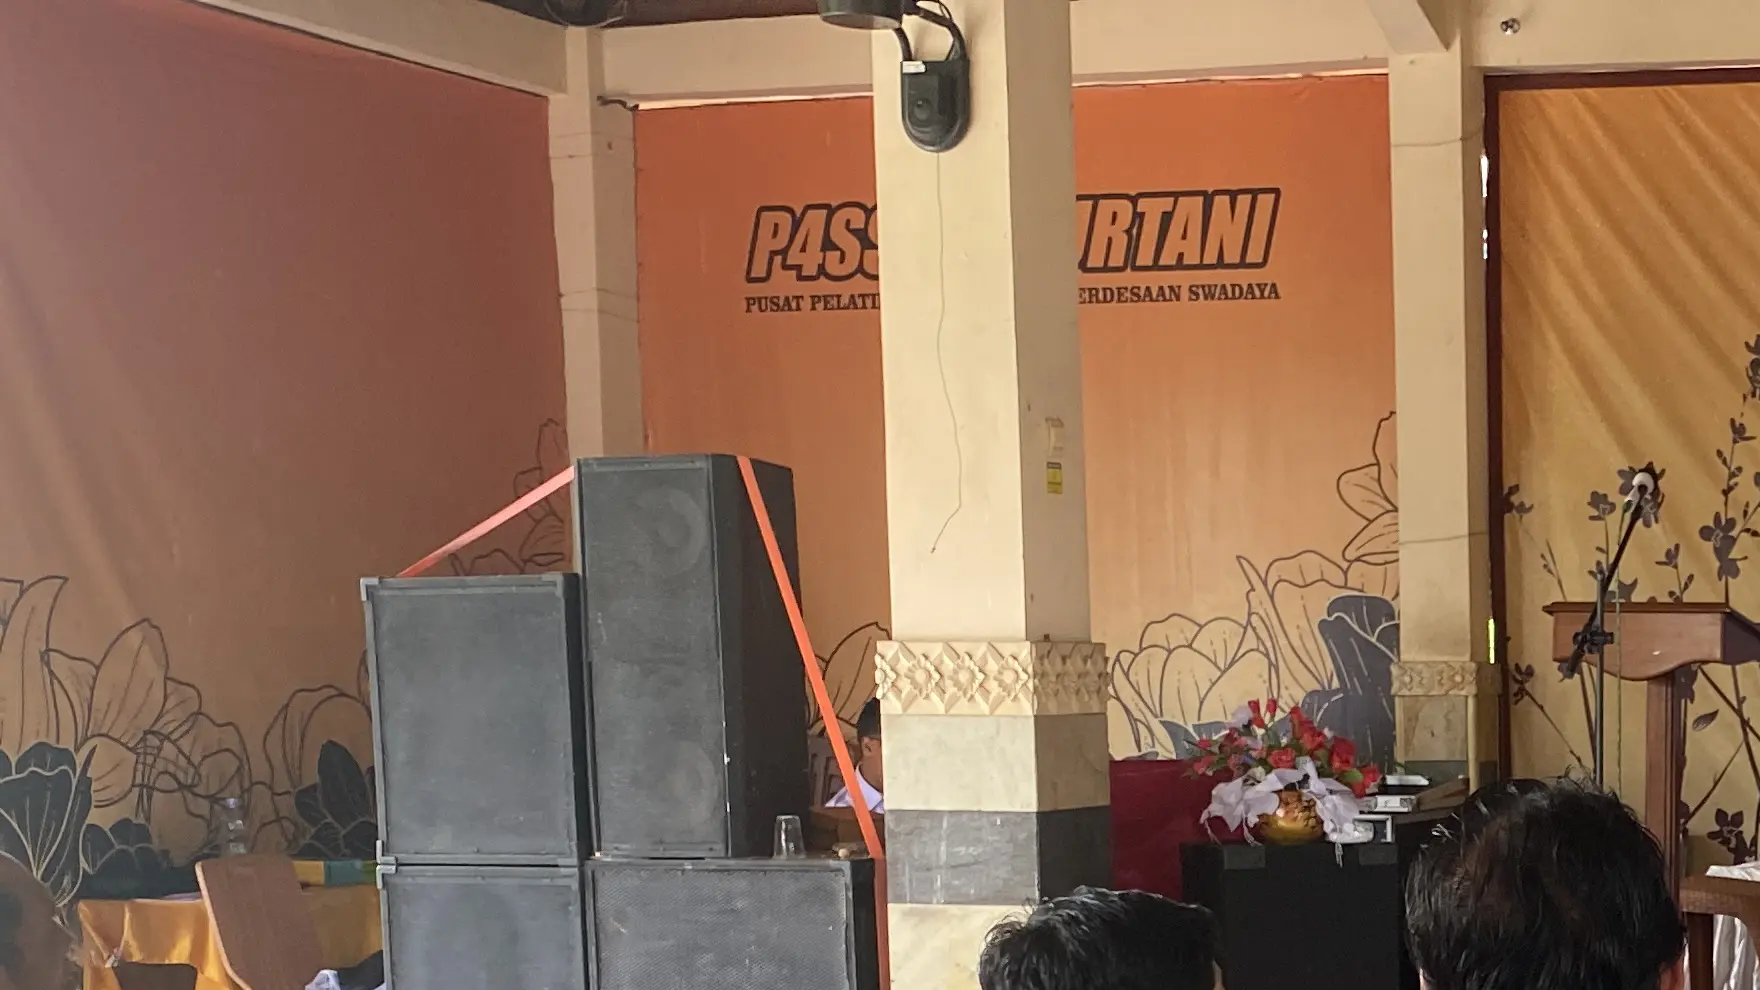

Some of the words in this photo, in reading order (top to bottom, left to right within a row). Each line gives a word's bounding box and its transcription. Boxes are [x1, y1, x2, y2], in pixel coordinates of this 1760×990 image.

[745, 296, 804, 313] PUSAT
[1078, 285, 1181, 304] ERDESAAN
[1187, 282, 1281, 301] SWADAYA
